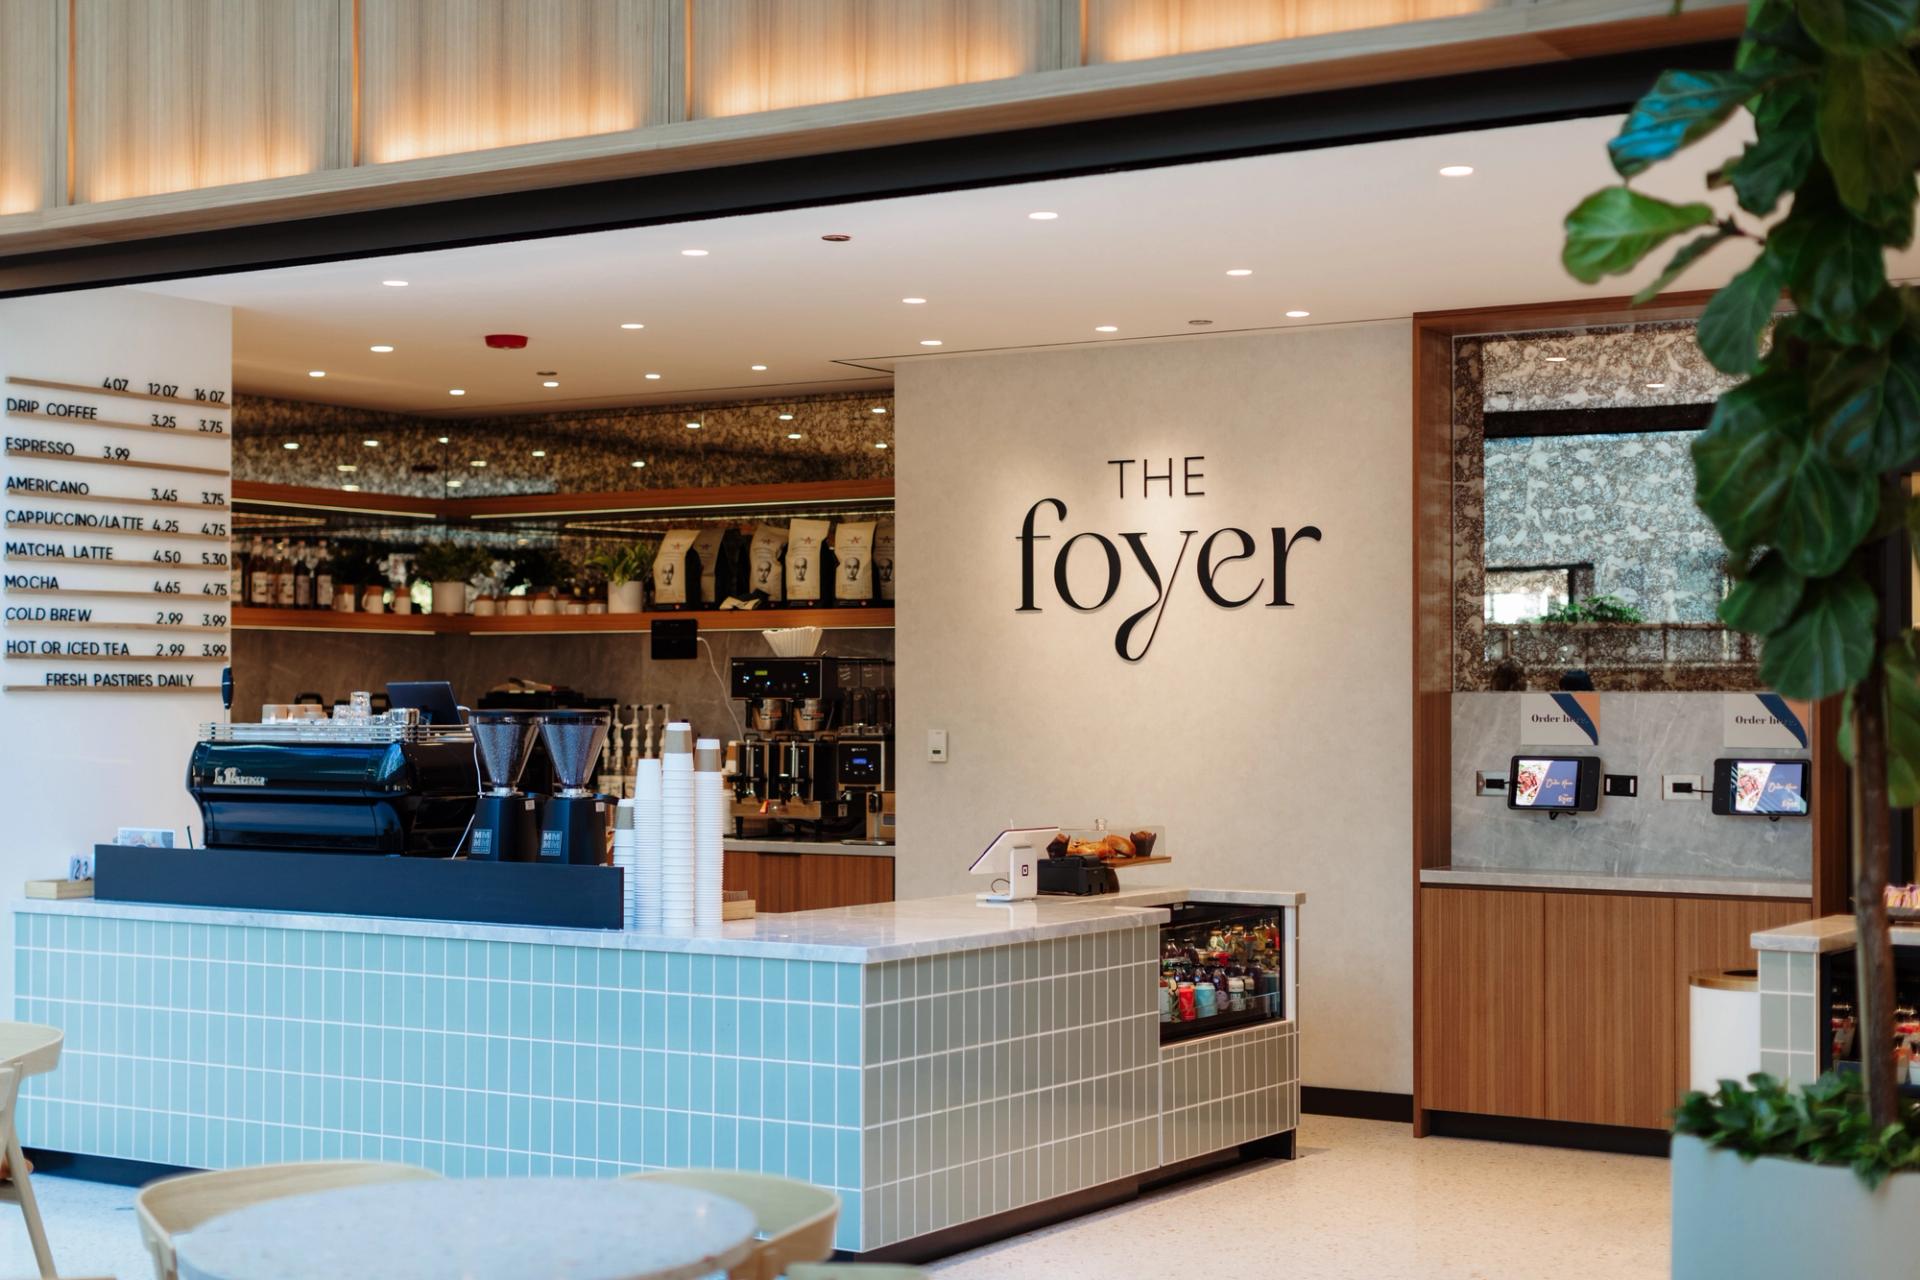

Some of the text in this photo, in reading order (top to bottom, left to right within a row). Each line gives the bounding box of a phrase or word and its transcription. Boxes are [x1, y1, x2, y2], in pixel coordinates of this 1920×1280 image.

[209, 391, 225, 404] OZ
[6, 398, 223, 433] DRIP COFFEE 3.25 3.75
[6, 437, 130, 461] ESPRESSO 3.99
[1108, 456, 1205, 499] THE
[6, 476, 225, 506] AMERICANO 3.45 3.75
[153, 520, 179, 533] 4.25
[202, 523, 226, 537] 4.75
[6, 542, 228, 566] MATCHA LATTE 4.50 5.30
[5, 575, 228, 597] MOCHA 4.65 4.75
[1015, 498, 1322, 662] foyer
[6, 607, 227, 627] COLD BREW 2.99 3.99
[7, 640, 227, 657] HOT OR ICED TEA 2.99 3.99
[46, 673, 194, 687] FRESH PASTRIES DAILY
[1531, 714, 1560, 723] Order
[1735, 716, 1766, 725] Order
